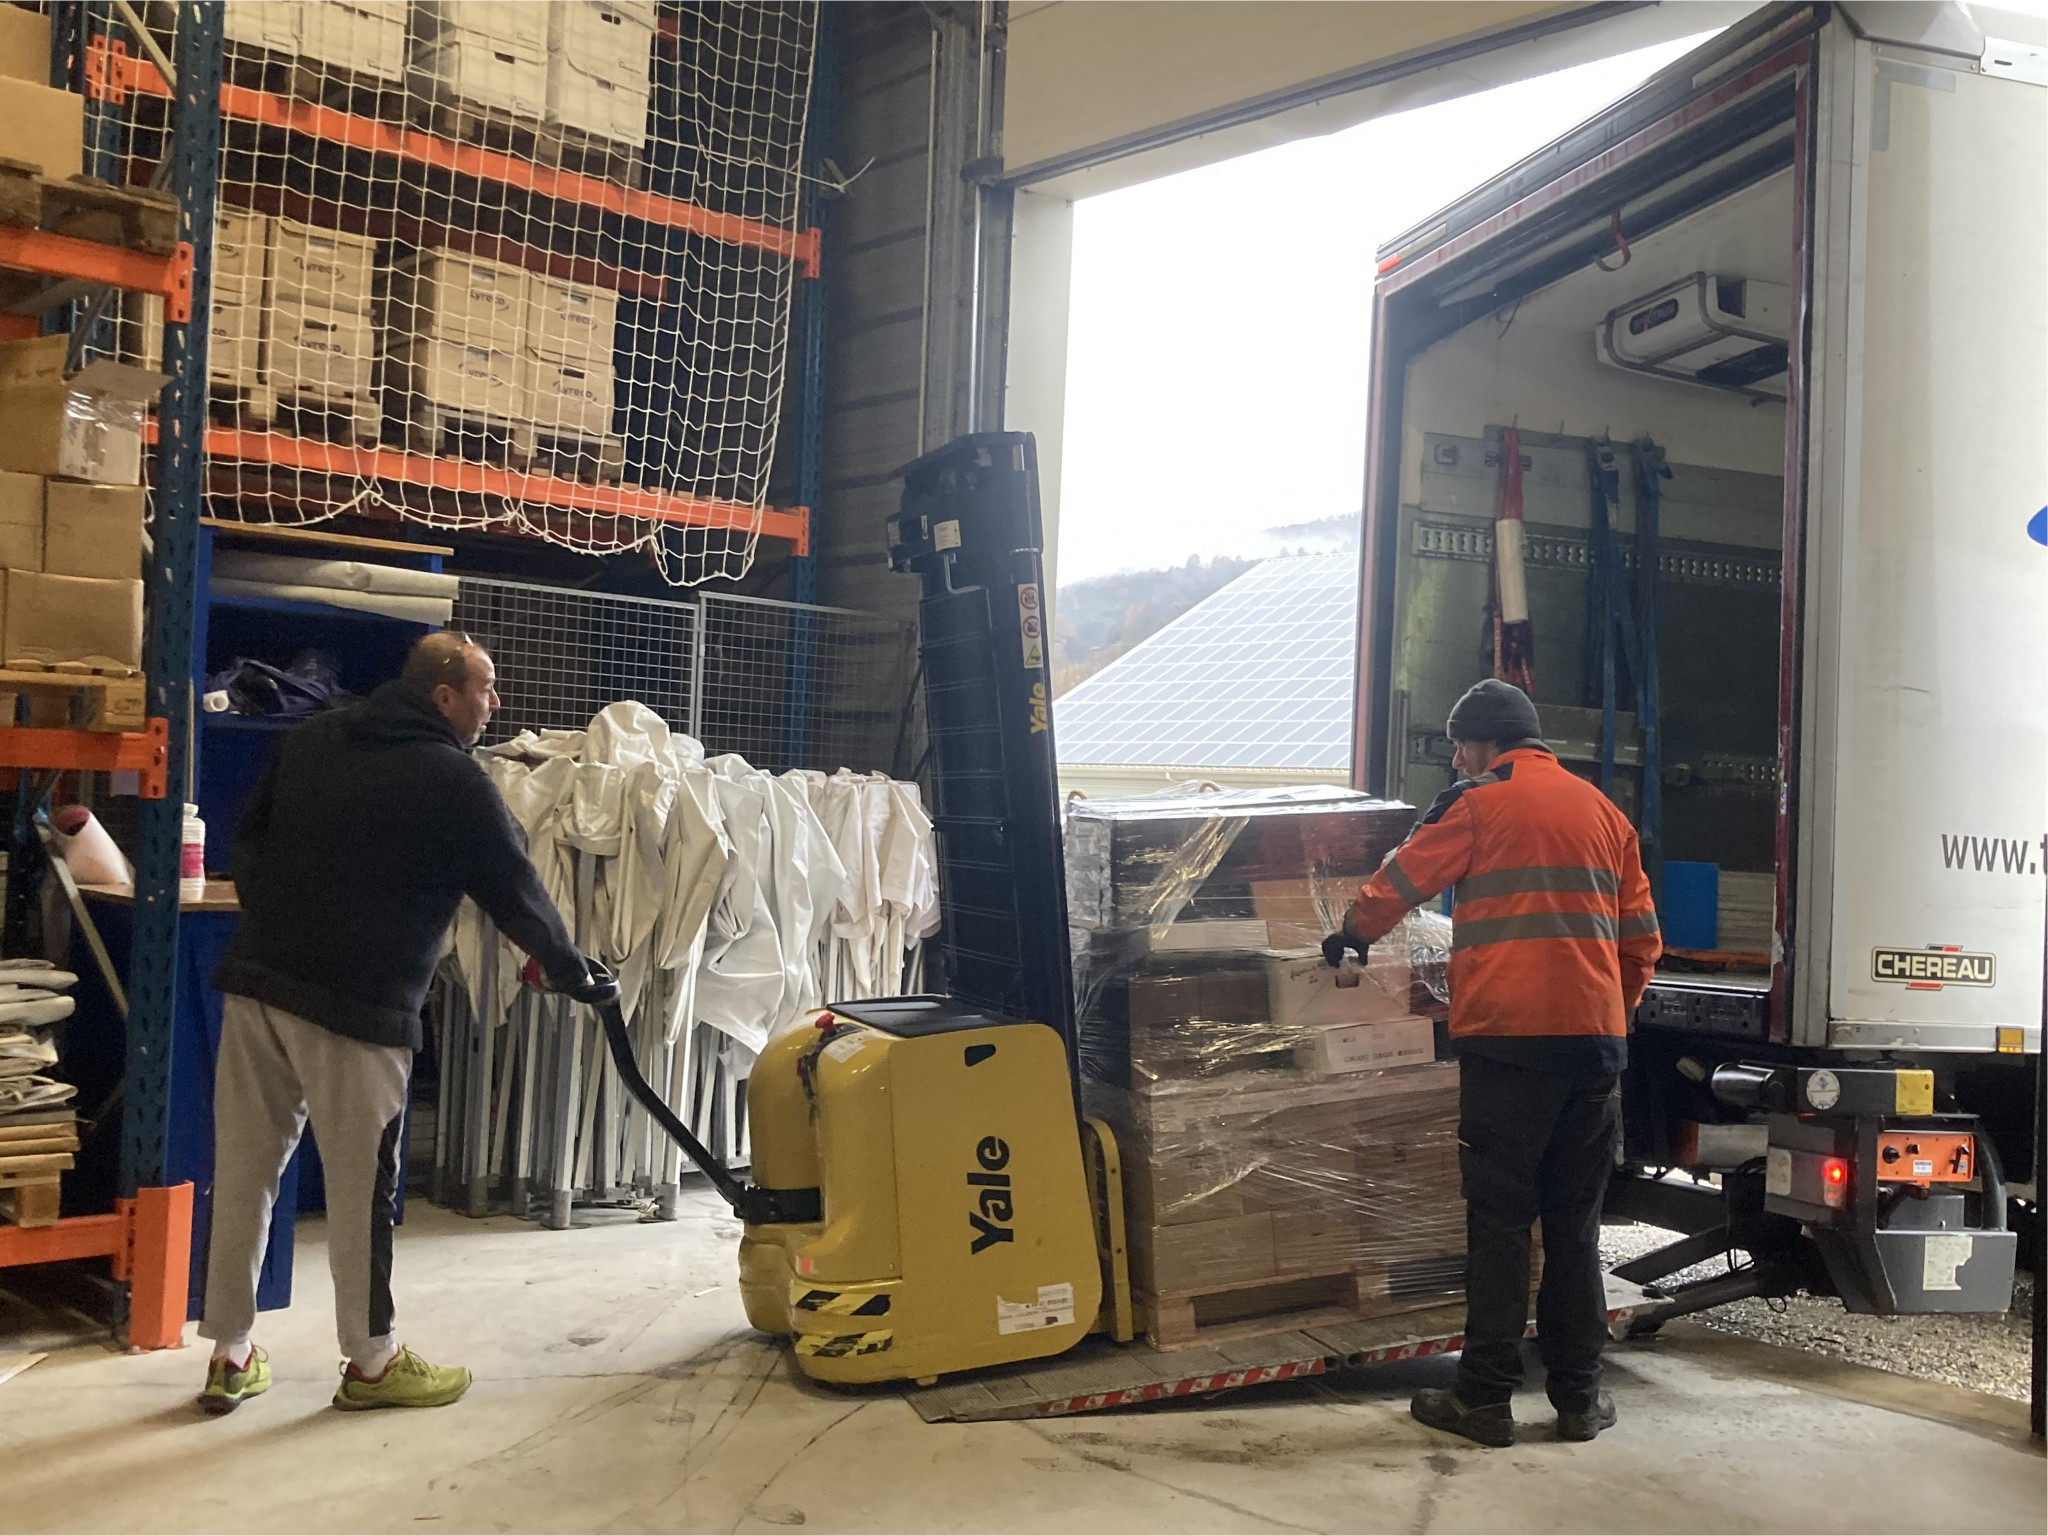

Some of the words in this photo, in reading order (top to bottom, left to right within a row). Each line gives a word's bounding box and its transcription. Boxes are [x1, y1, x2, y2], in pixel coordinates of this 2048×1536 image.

[470, 288, 506, 305] Lyreco
[1029, 682, 1048, 735] Yale
[1877, 954, 1990, 980] CHEREAU
[966, 1135, 1015, 1255] Yale
